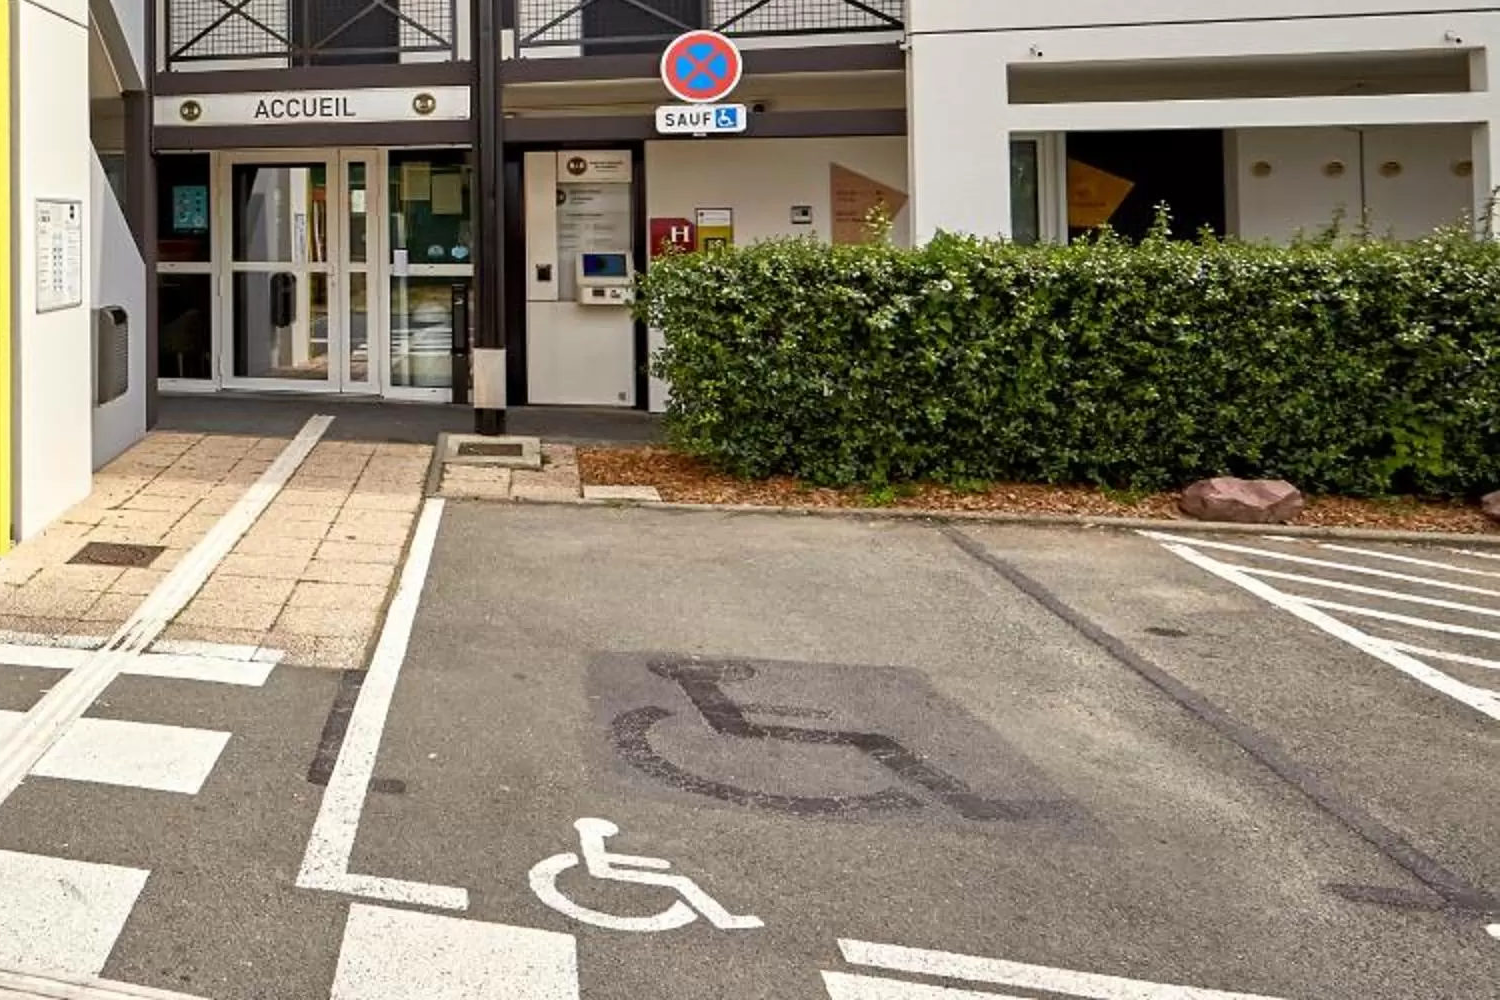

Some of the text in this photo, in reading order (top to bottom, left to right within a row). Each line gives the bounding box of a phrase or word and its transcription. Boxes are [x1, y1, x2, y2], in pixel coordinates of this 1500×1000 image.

[253, 96, 357, 119] ACCUEIL
[664, 111, 712, 127] SAUF
[670, 225, 691, 243] H
